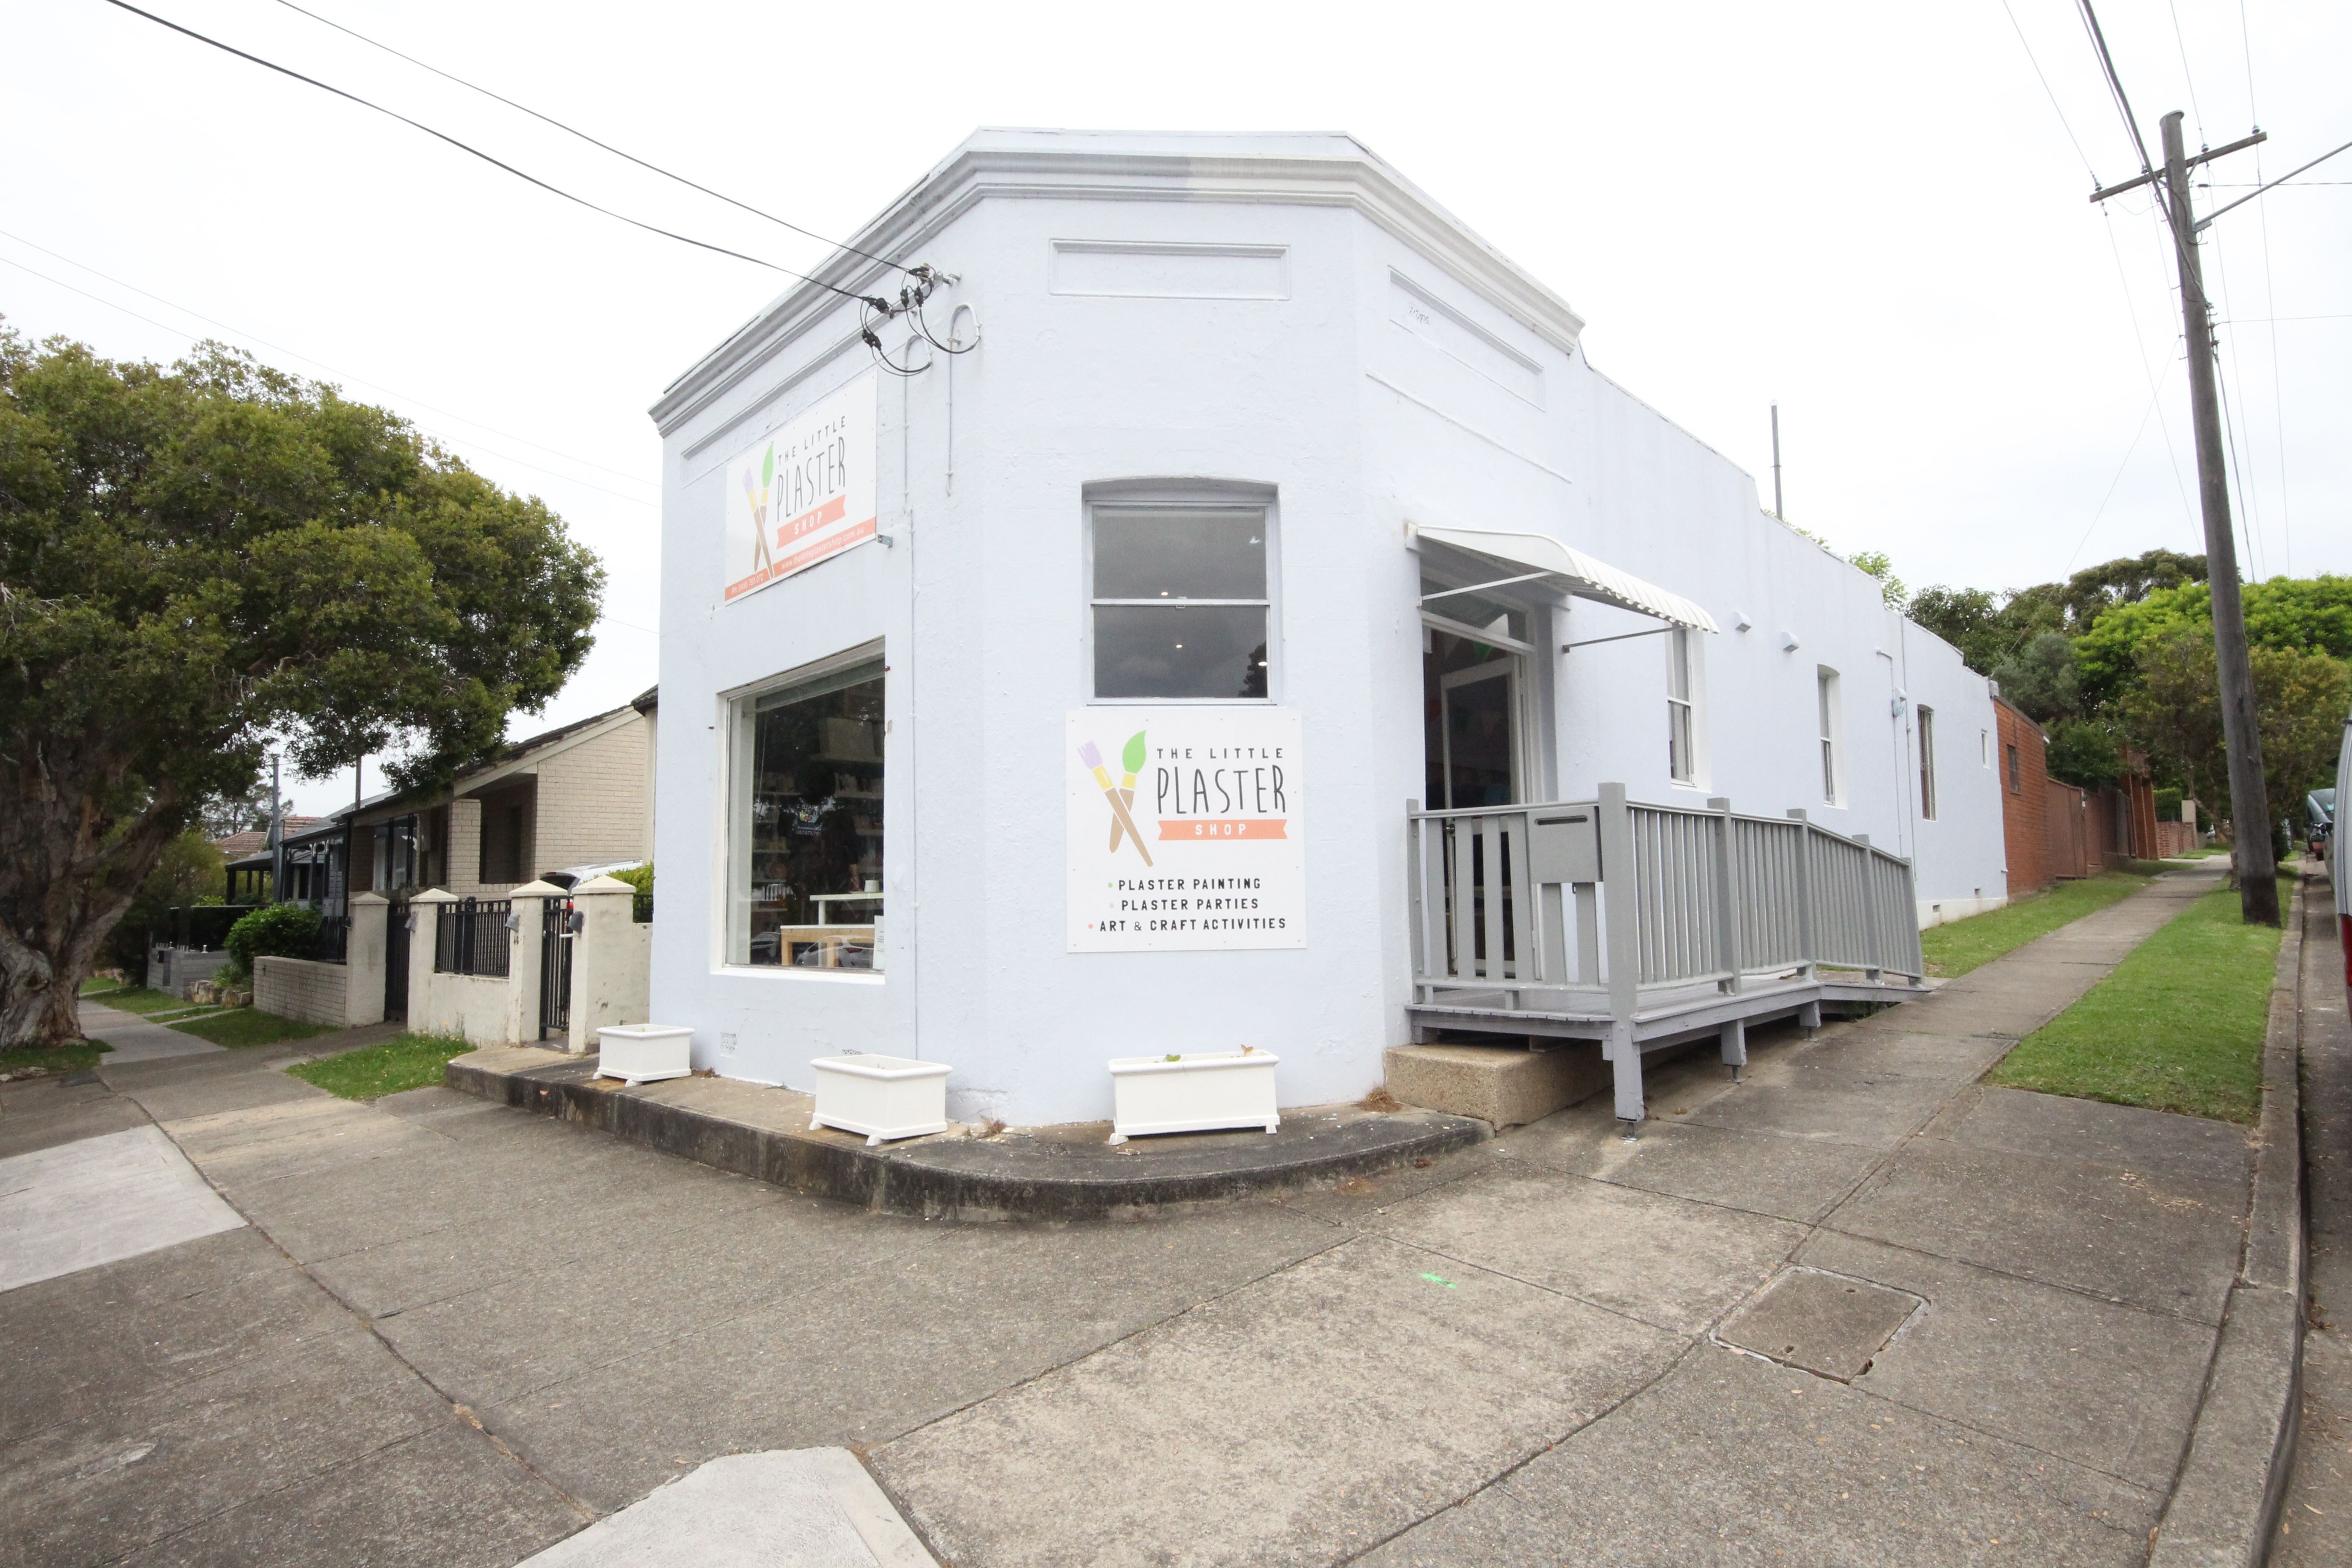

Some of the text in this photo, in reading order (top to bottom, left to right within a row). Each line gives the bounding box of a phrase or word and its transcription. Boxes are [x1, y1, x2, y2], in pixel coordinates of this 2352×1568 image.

[778, 416, 845, 466] THE LITTLE
[777, 436, 845, 522] PLASTER
[794, 511, 822, 535] SHOP
[1157, 748, 1283, 759] THE LITTLE
[1157, 764, 1286, 814] PLASTER
[1195, 823, 1246, 835] SHOP
[1118, 878, 1260, 891] PLASTER PAINTING
[1122, 898, 1258, 911] PLASTER PARTIES
[1100, 918, 1286, 932] ART & CRAFT ACTIVITIES
